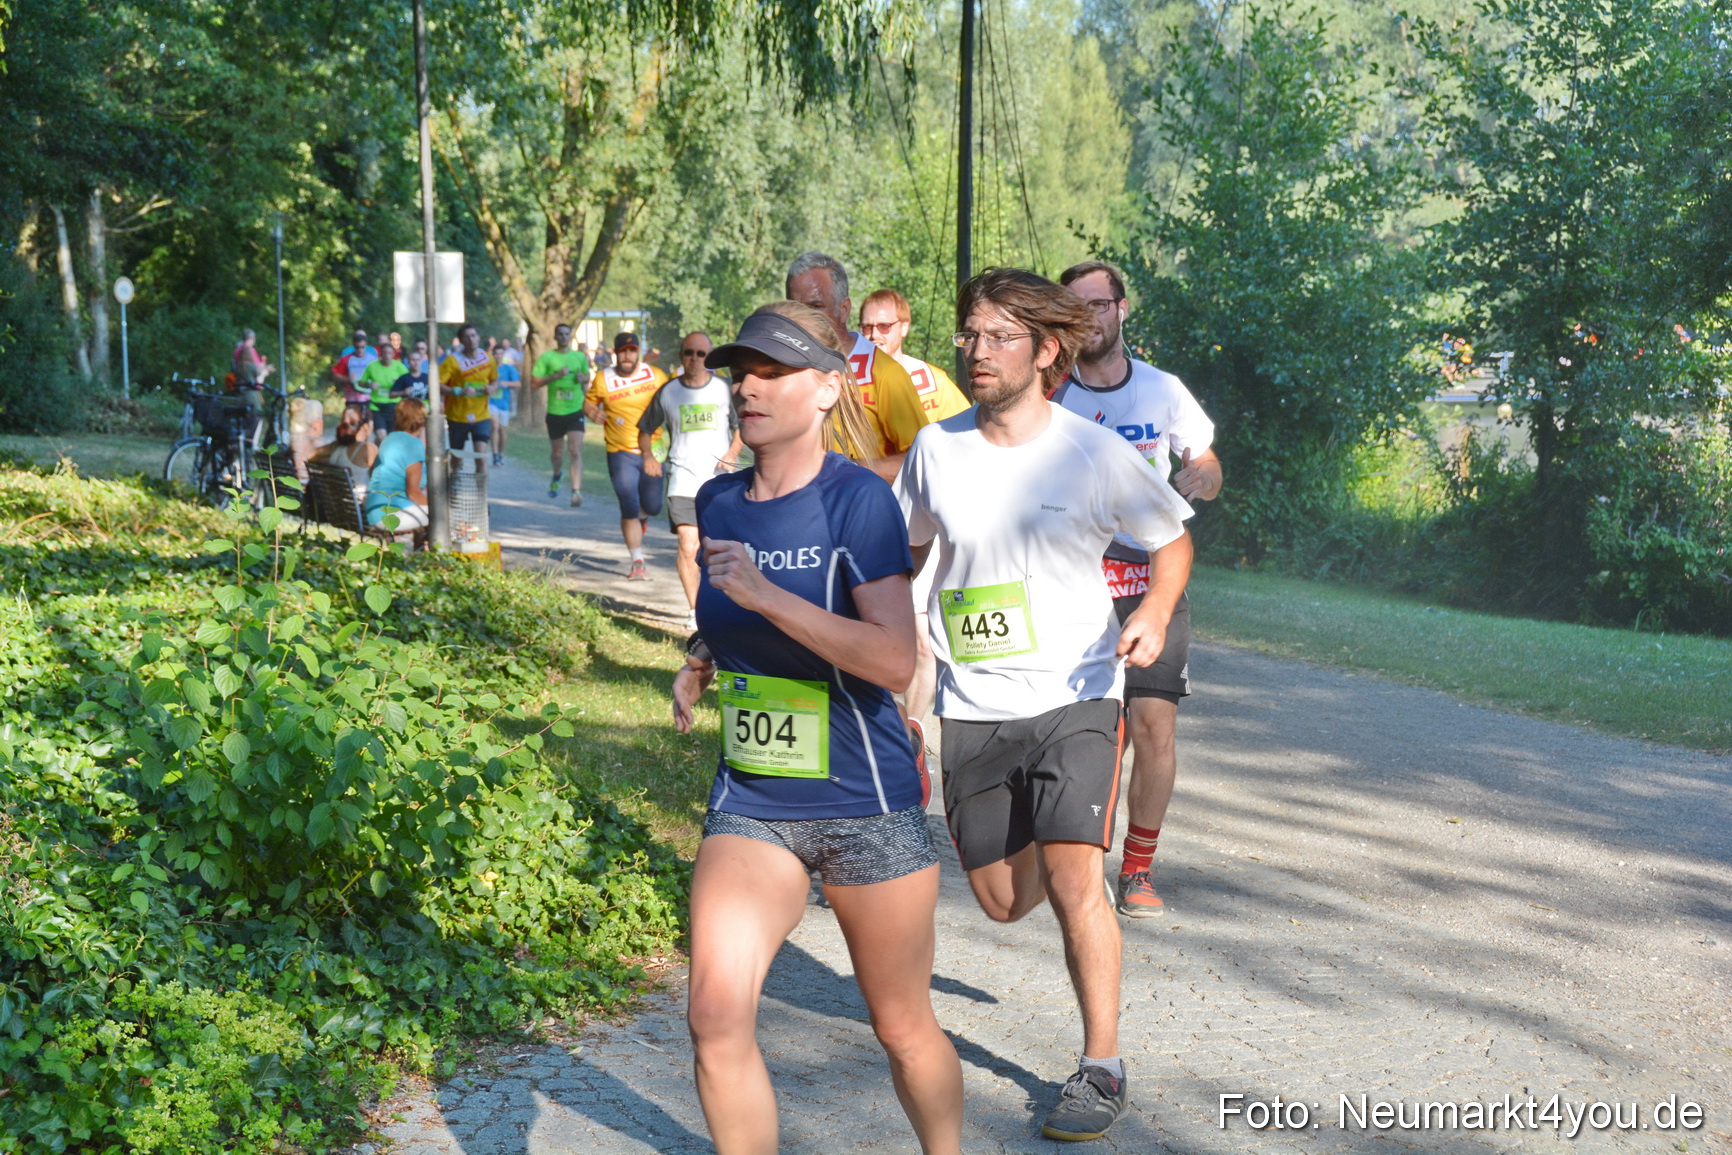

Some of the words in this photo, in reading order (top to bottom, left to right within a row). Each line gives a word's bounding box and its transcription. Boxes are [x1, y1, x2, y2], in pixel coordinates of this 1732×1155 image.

[609, 391, 631, 403] MAX
[685, 412, 714, 425] 2148
[1041, 503, 1067, 513] benger
[961, 611, 1010, 641] 443
[988, 638, 1011, 647] Daniel
[735, 709, 797, 748] 504
